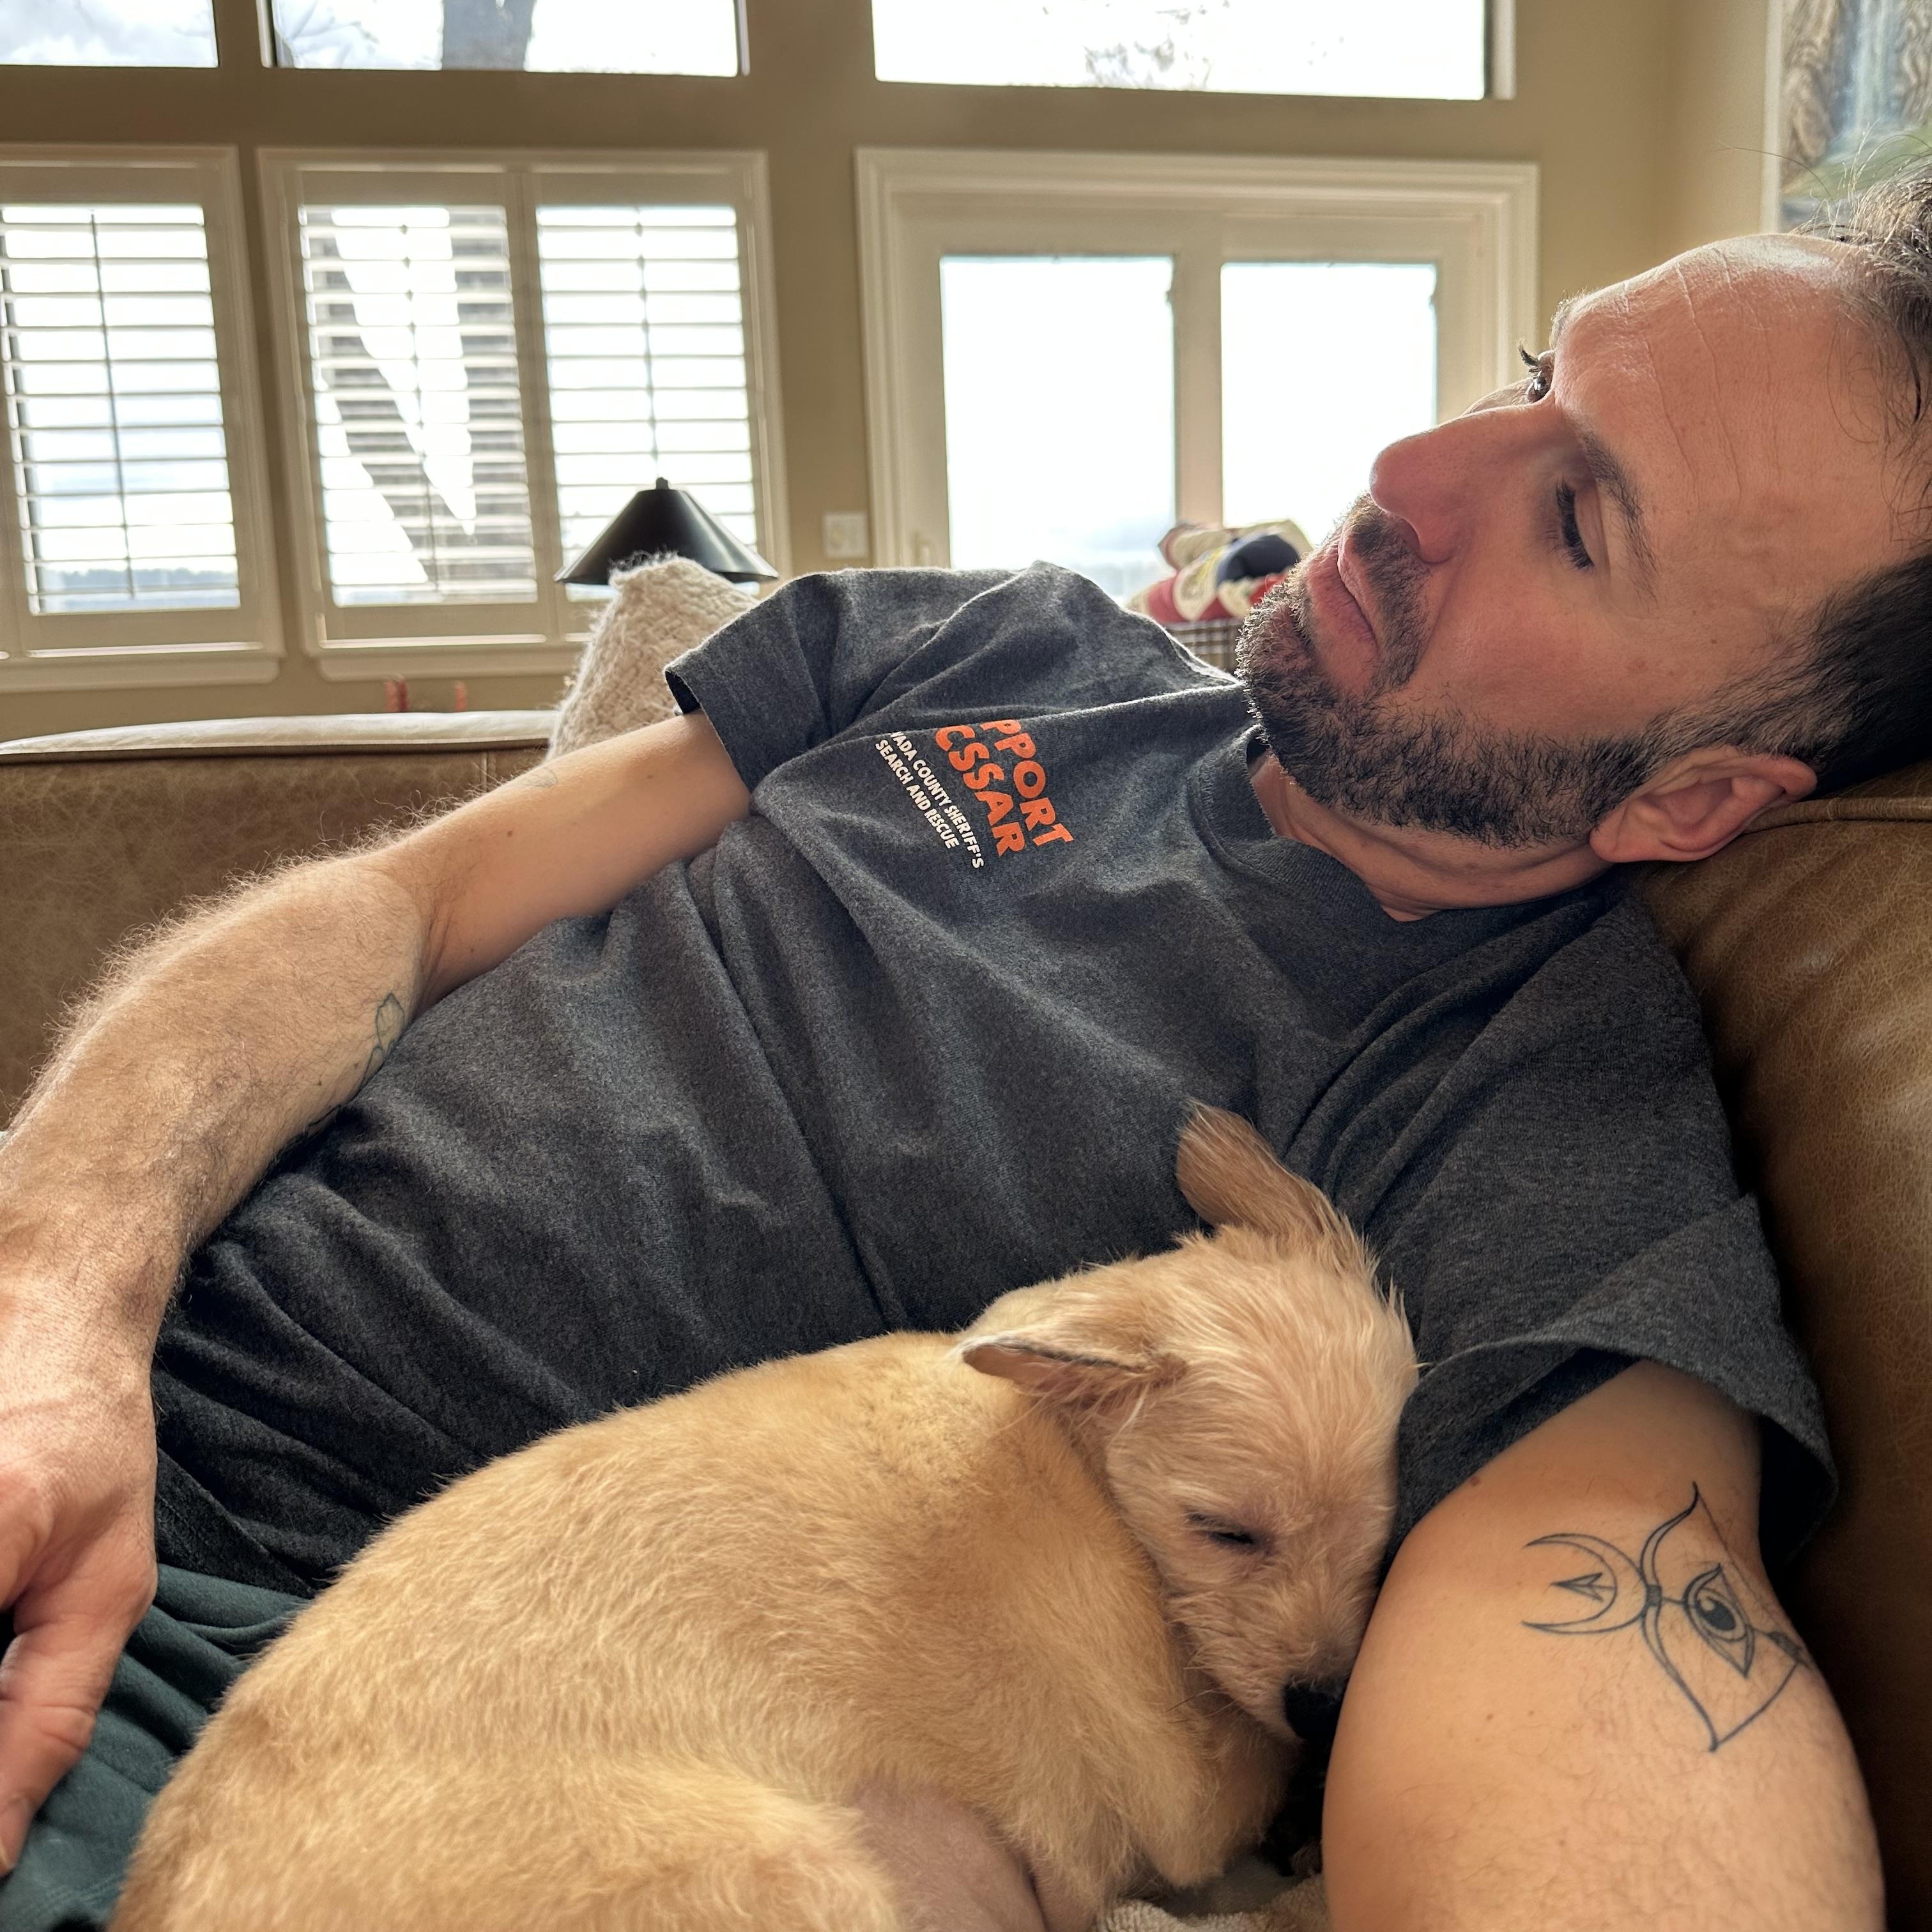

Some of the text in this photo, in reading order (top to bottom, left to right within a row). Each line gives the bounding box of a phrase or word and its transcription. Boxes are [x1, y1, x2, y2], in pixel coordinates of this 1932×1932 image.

[875, 739, 960, 849] SEARCH AND RESCUE
[913, 759, 952, 806] COUNTY
[944, 805, 984, 869] SHERIFF'S
[935, 725, 1026, 857] CSSAR
